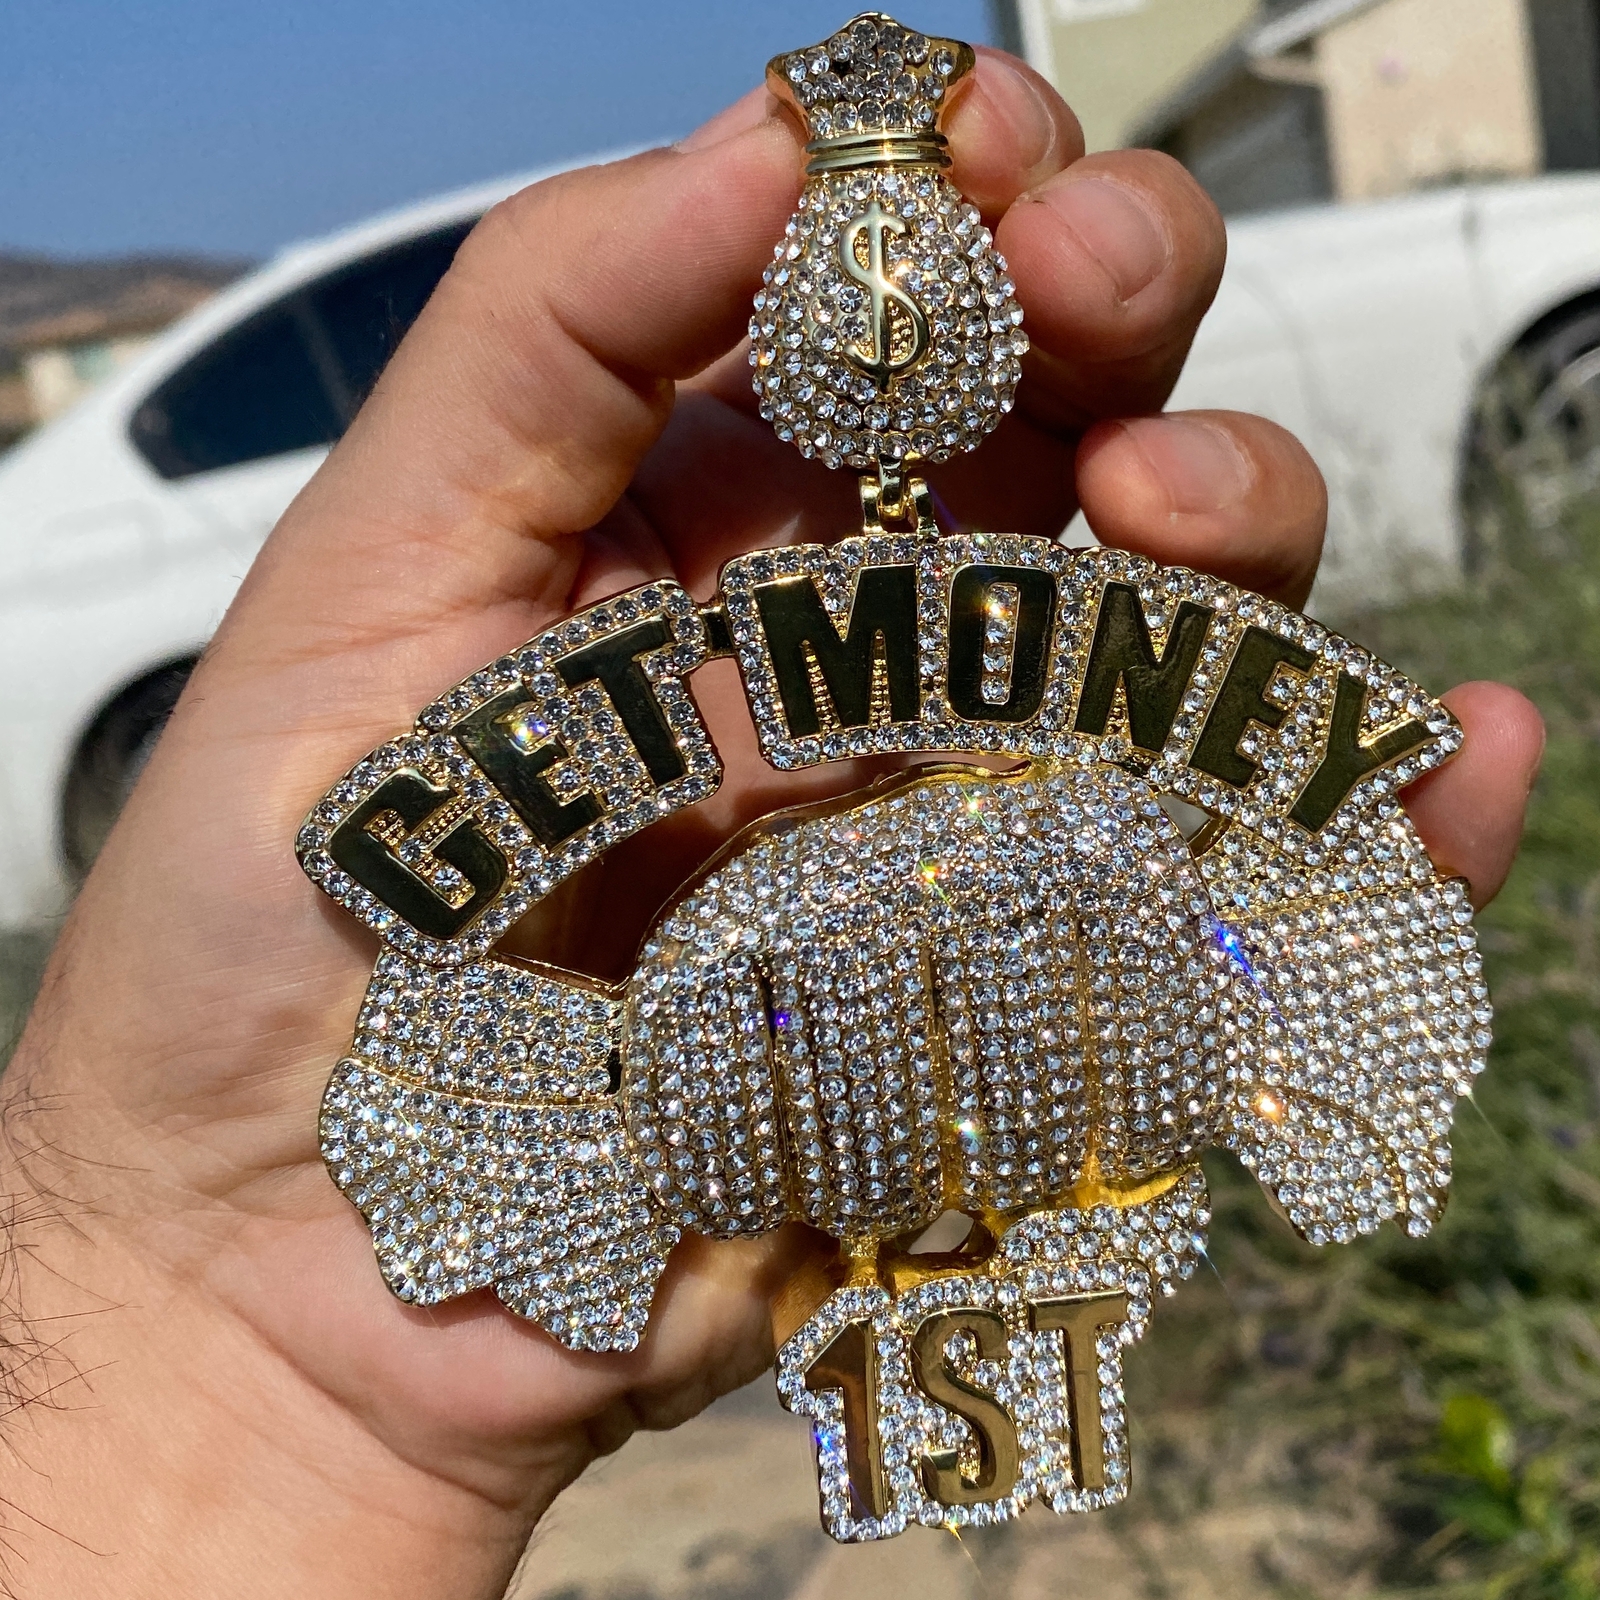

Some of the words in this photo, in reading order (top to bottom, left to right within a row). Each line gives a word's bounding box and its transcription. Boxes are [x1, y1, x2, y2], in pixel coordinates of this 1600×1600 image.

[842, 203, 928, 388] $
[332, 617, 690, 938] GET
[754, 562, 1430, 836] MONEY
[804, 1290, 1132, 1520] 1ST
